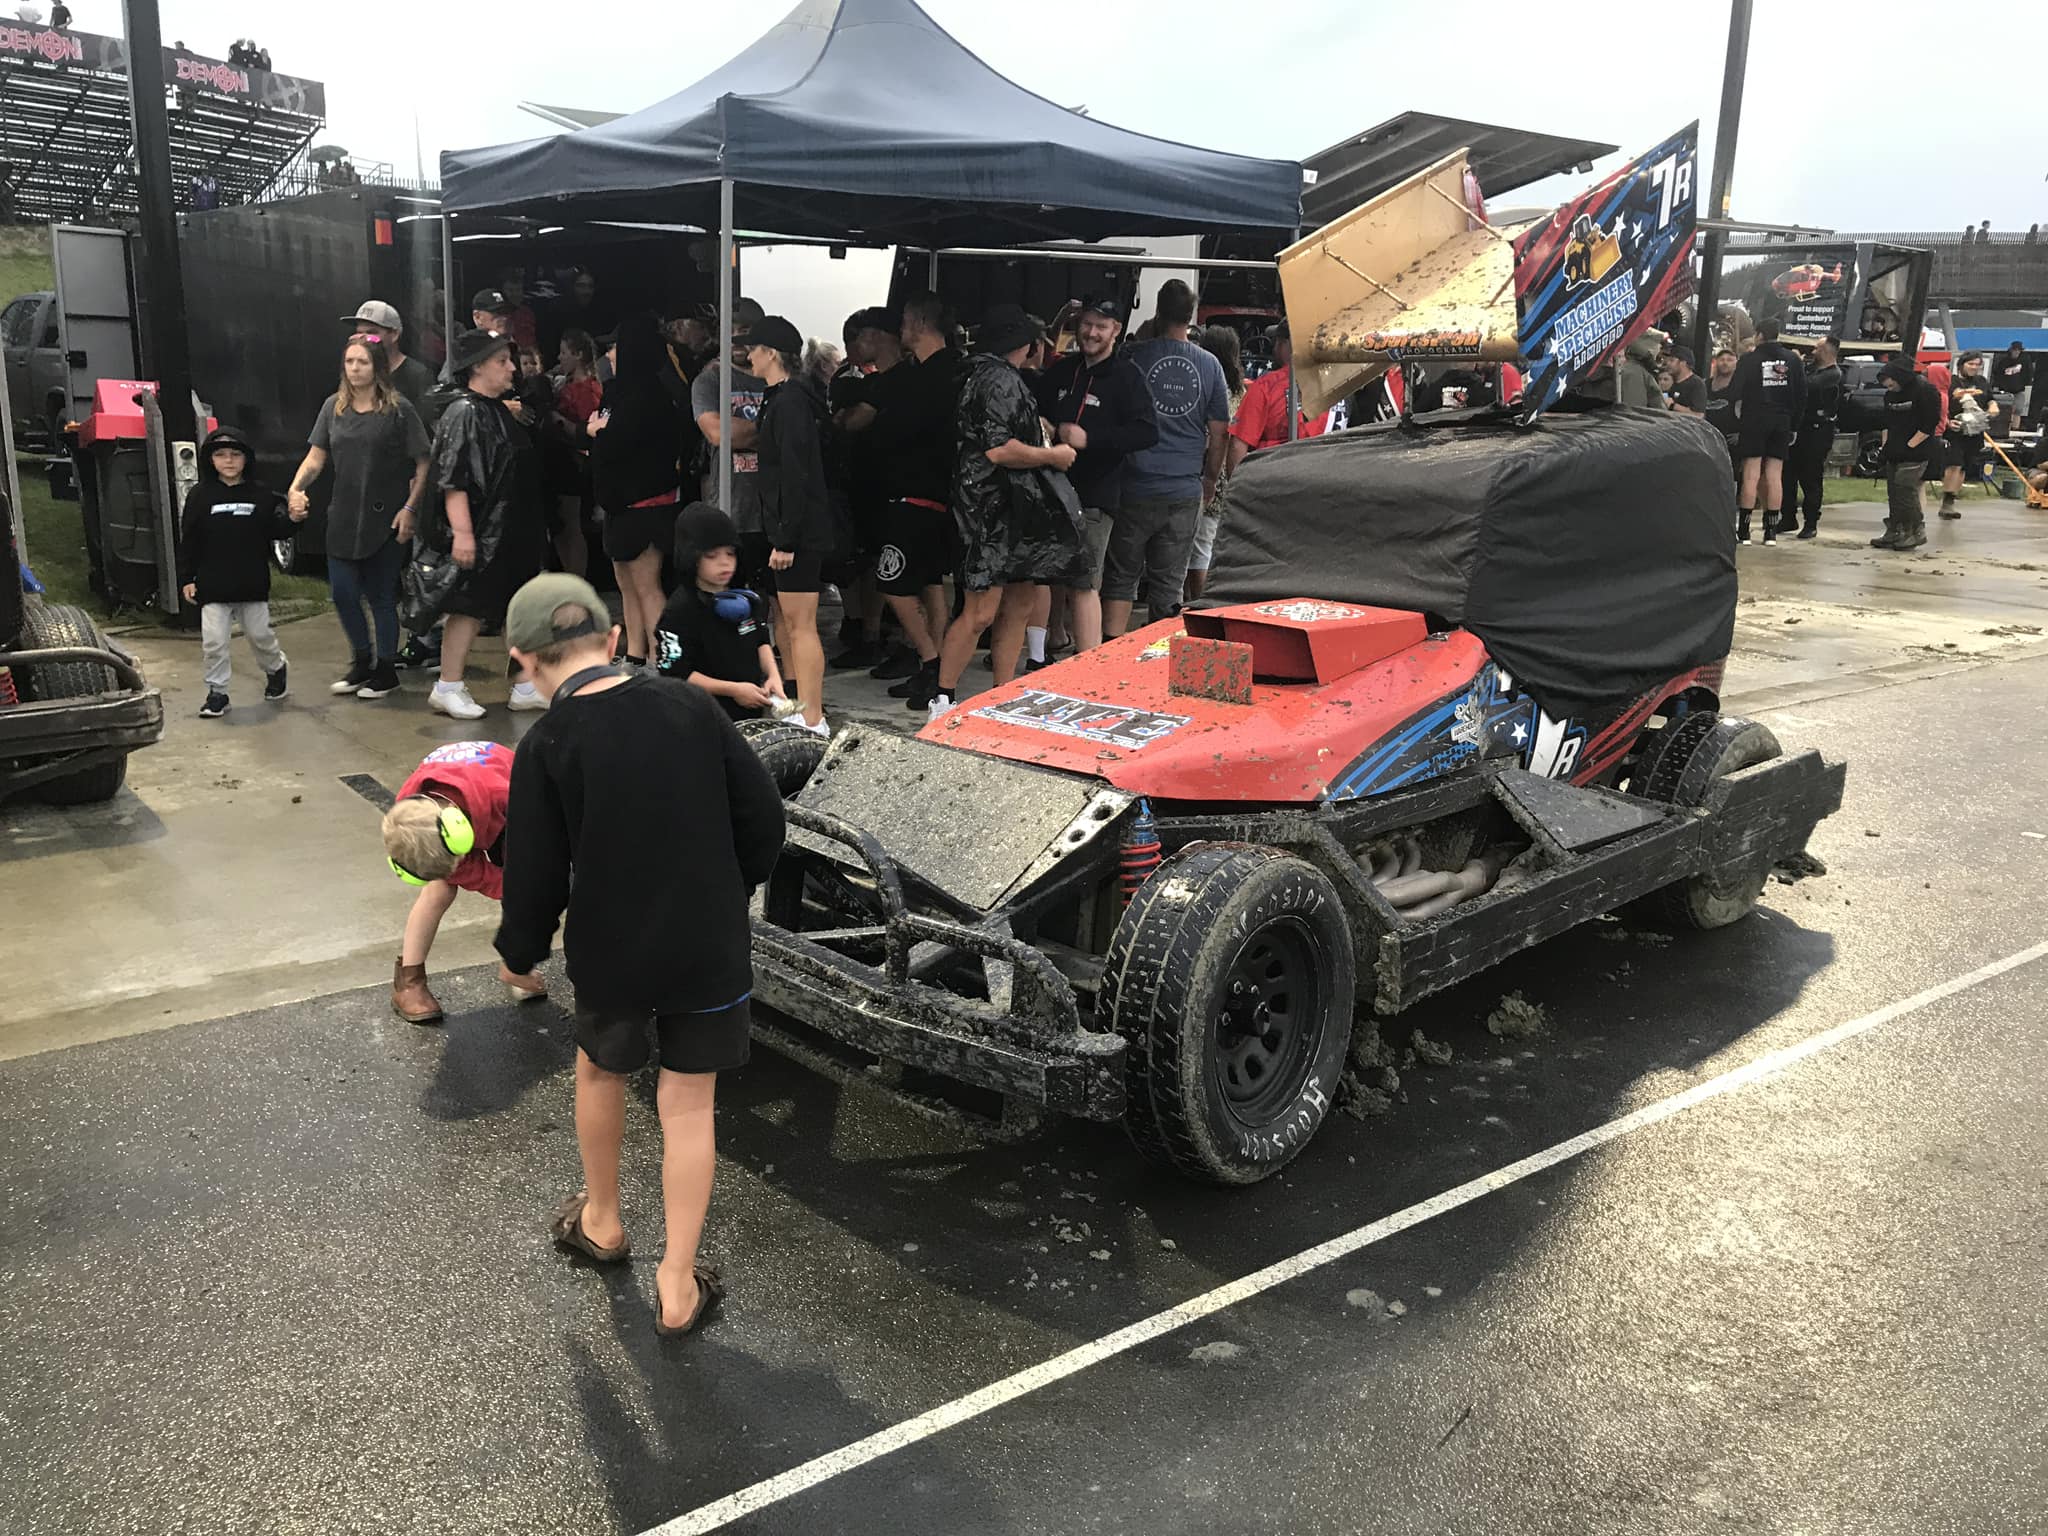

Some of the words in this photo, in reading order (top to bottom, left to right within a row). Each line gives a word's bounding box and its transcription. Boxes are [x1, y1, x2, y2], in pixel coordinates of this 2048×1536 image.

[1555, 268, 1633, 342] MACHINERY
[1797, 313, 1833, 323] Canterbury's
[1812, 306, 1835, 314] support
[1557, 289, 1638, 367] SPECIALISTS
[1400, 347, 1479, 355] PHOOGRAPHY
[1573, 324, 1624, 371] LIMITED
